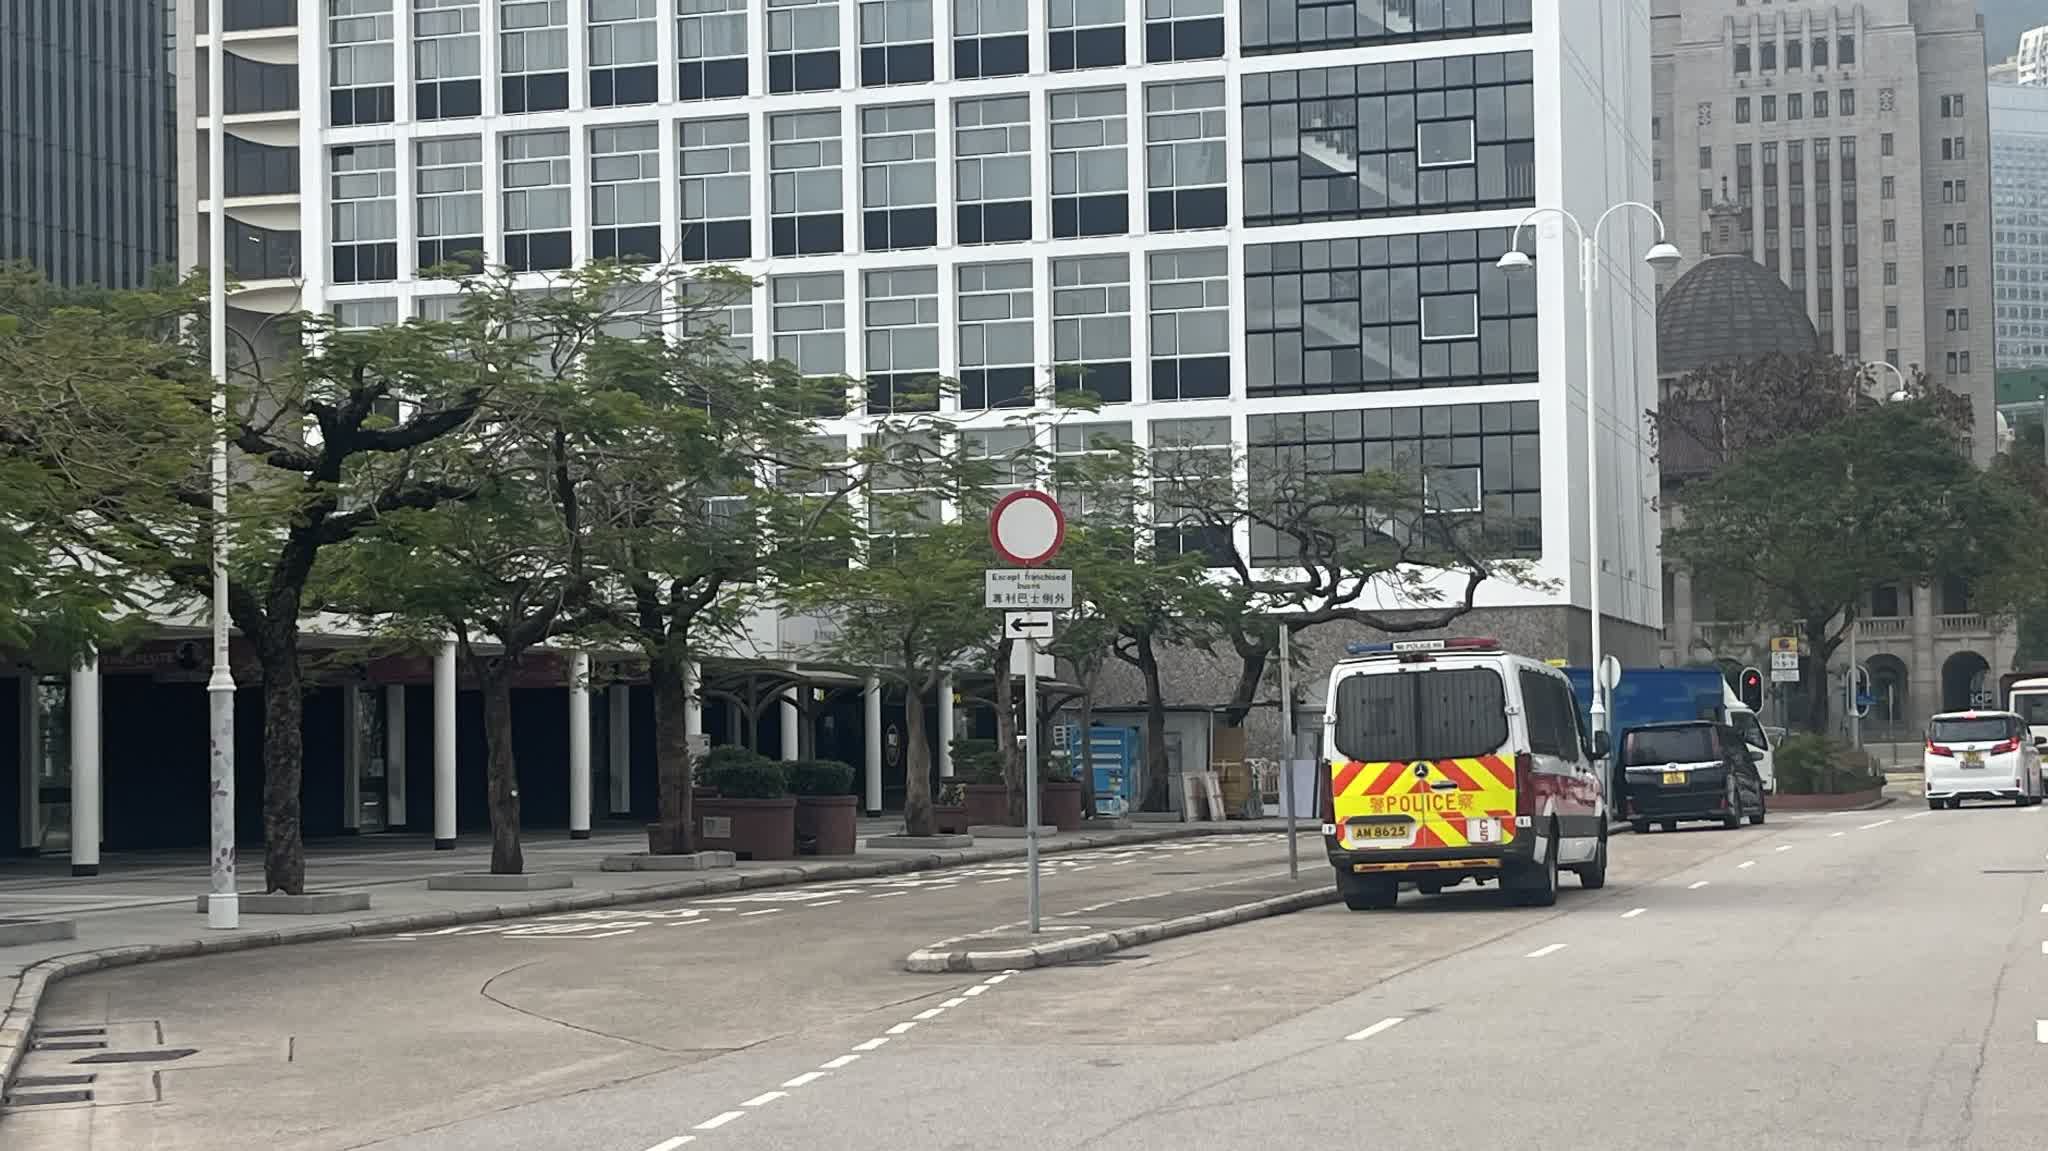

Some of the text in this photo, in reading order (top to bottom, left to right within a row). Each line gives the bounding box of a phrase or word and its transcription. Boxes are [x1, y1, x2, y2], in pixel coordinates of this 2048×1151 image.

[992, 573, 1067, 581] Except franchised
[1386, 793, 1457, 813] POLICE
[1374, 825, 1406, 837] 8625
